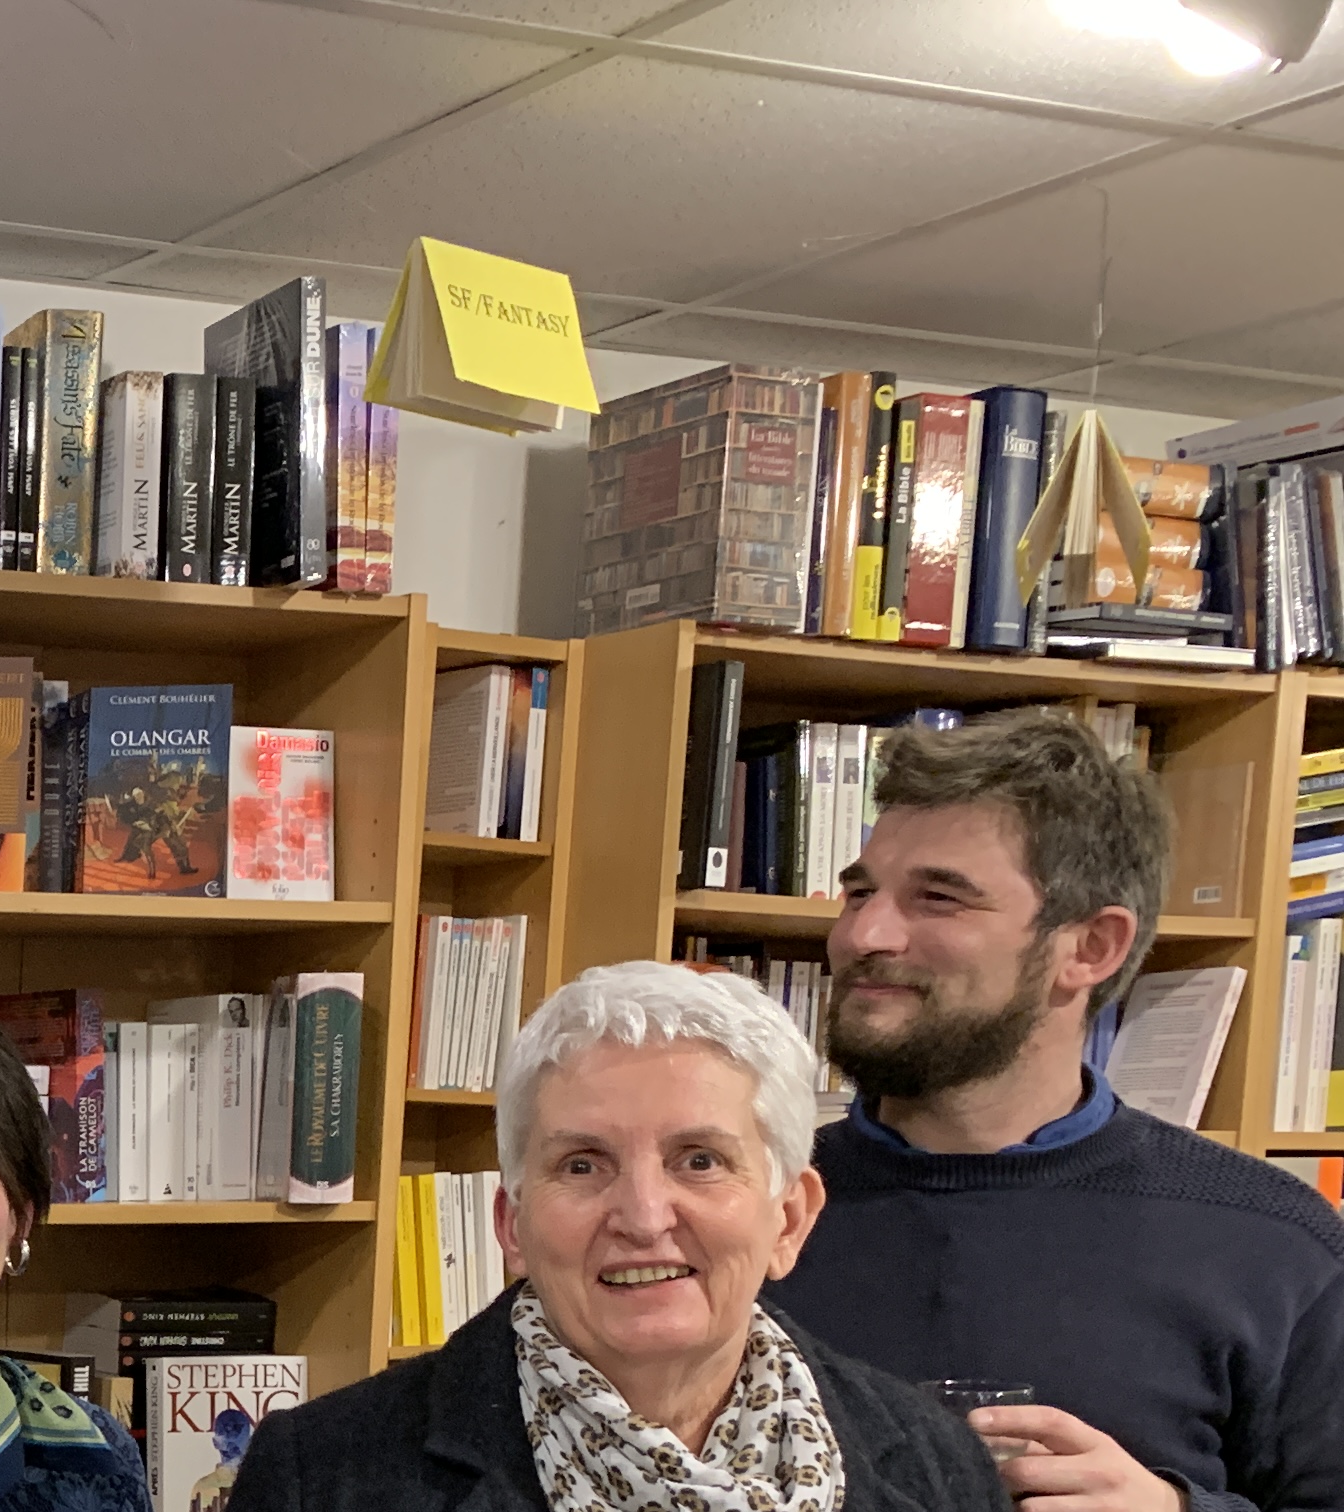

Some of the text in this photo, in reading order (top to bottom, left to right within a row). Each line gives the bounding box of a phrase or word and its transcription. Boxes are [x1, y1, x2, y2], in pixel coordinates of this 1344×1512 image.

[305, 297, 322, 398] SUR DUNE
[446, 284, 571, 339] SF/FANTASY
[65, 501, 79, 545] ROBIN
[132, 478, 149, 551] MARTIN
[180, 481, 198, 555] MARTIN
[223, 482, 242, 555] MARTIN
[895, 467, 911, 524] La Bible
[110, 729, 211, 747] OLANGAR
[110, 747, 211, 757] LE COMBAT DES OMBRES
[256, 729, 330, 752] Damasio
[223, 1032, 234, 1109] Philip K. Dick
[306, 1004, 330, 1163] LE ROYAUME DE CUIVRE
[330, 1034, 344, 1116] CHAKRABORTY
[77, 1096, 88, 1173] LA TRAHISON
[87, 1097, 98, 1172] DE CAMELOT
[72, 1366, 90, 1392] HILL
[167, 1363, 304, 1389] STEPHEN
